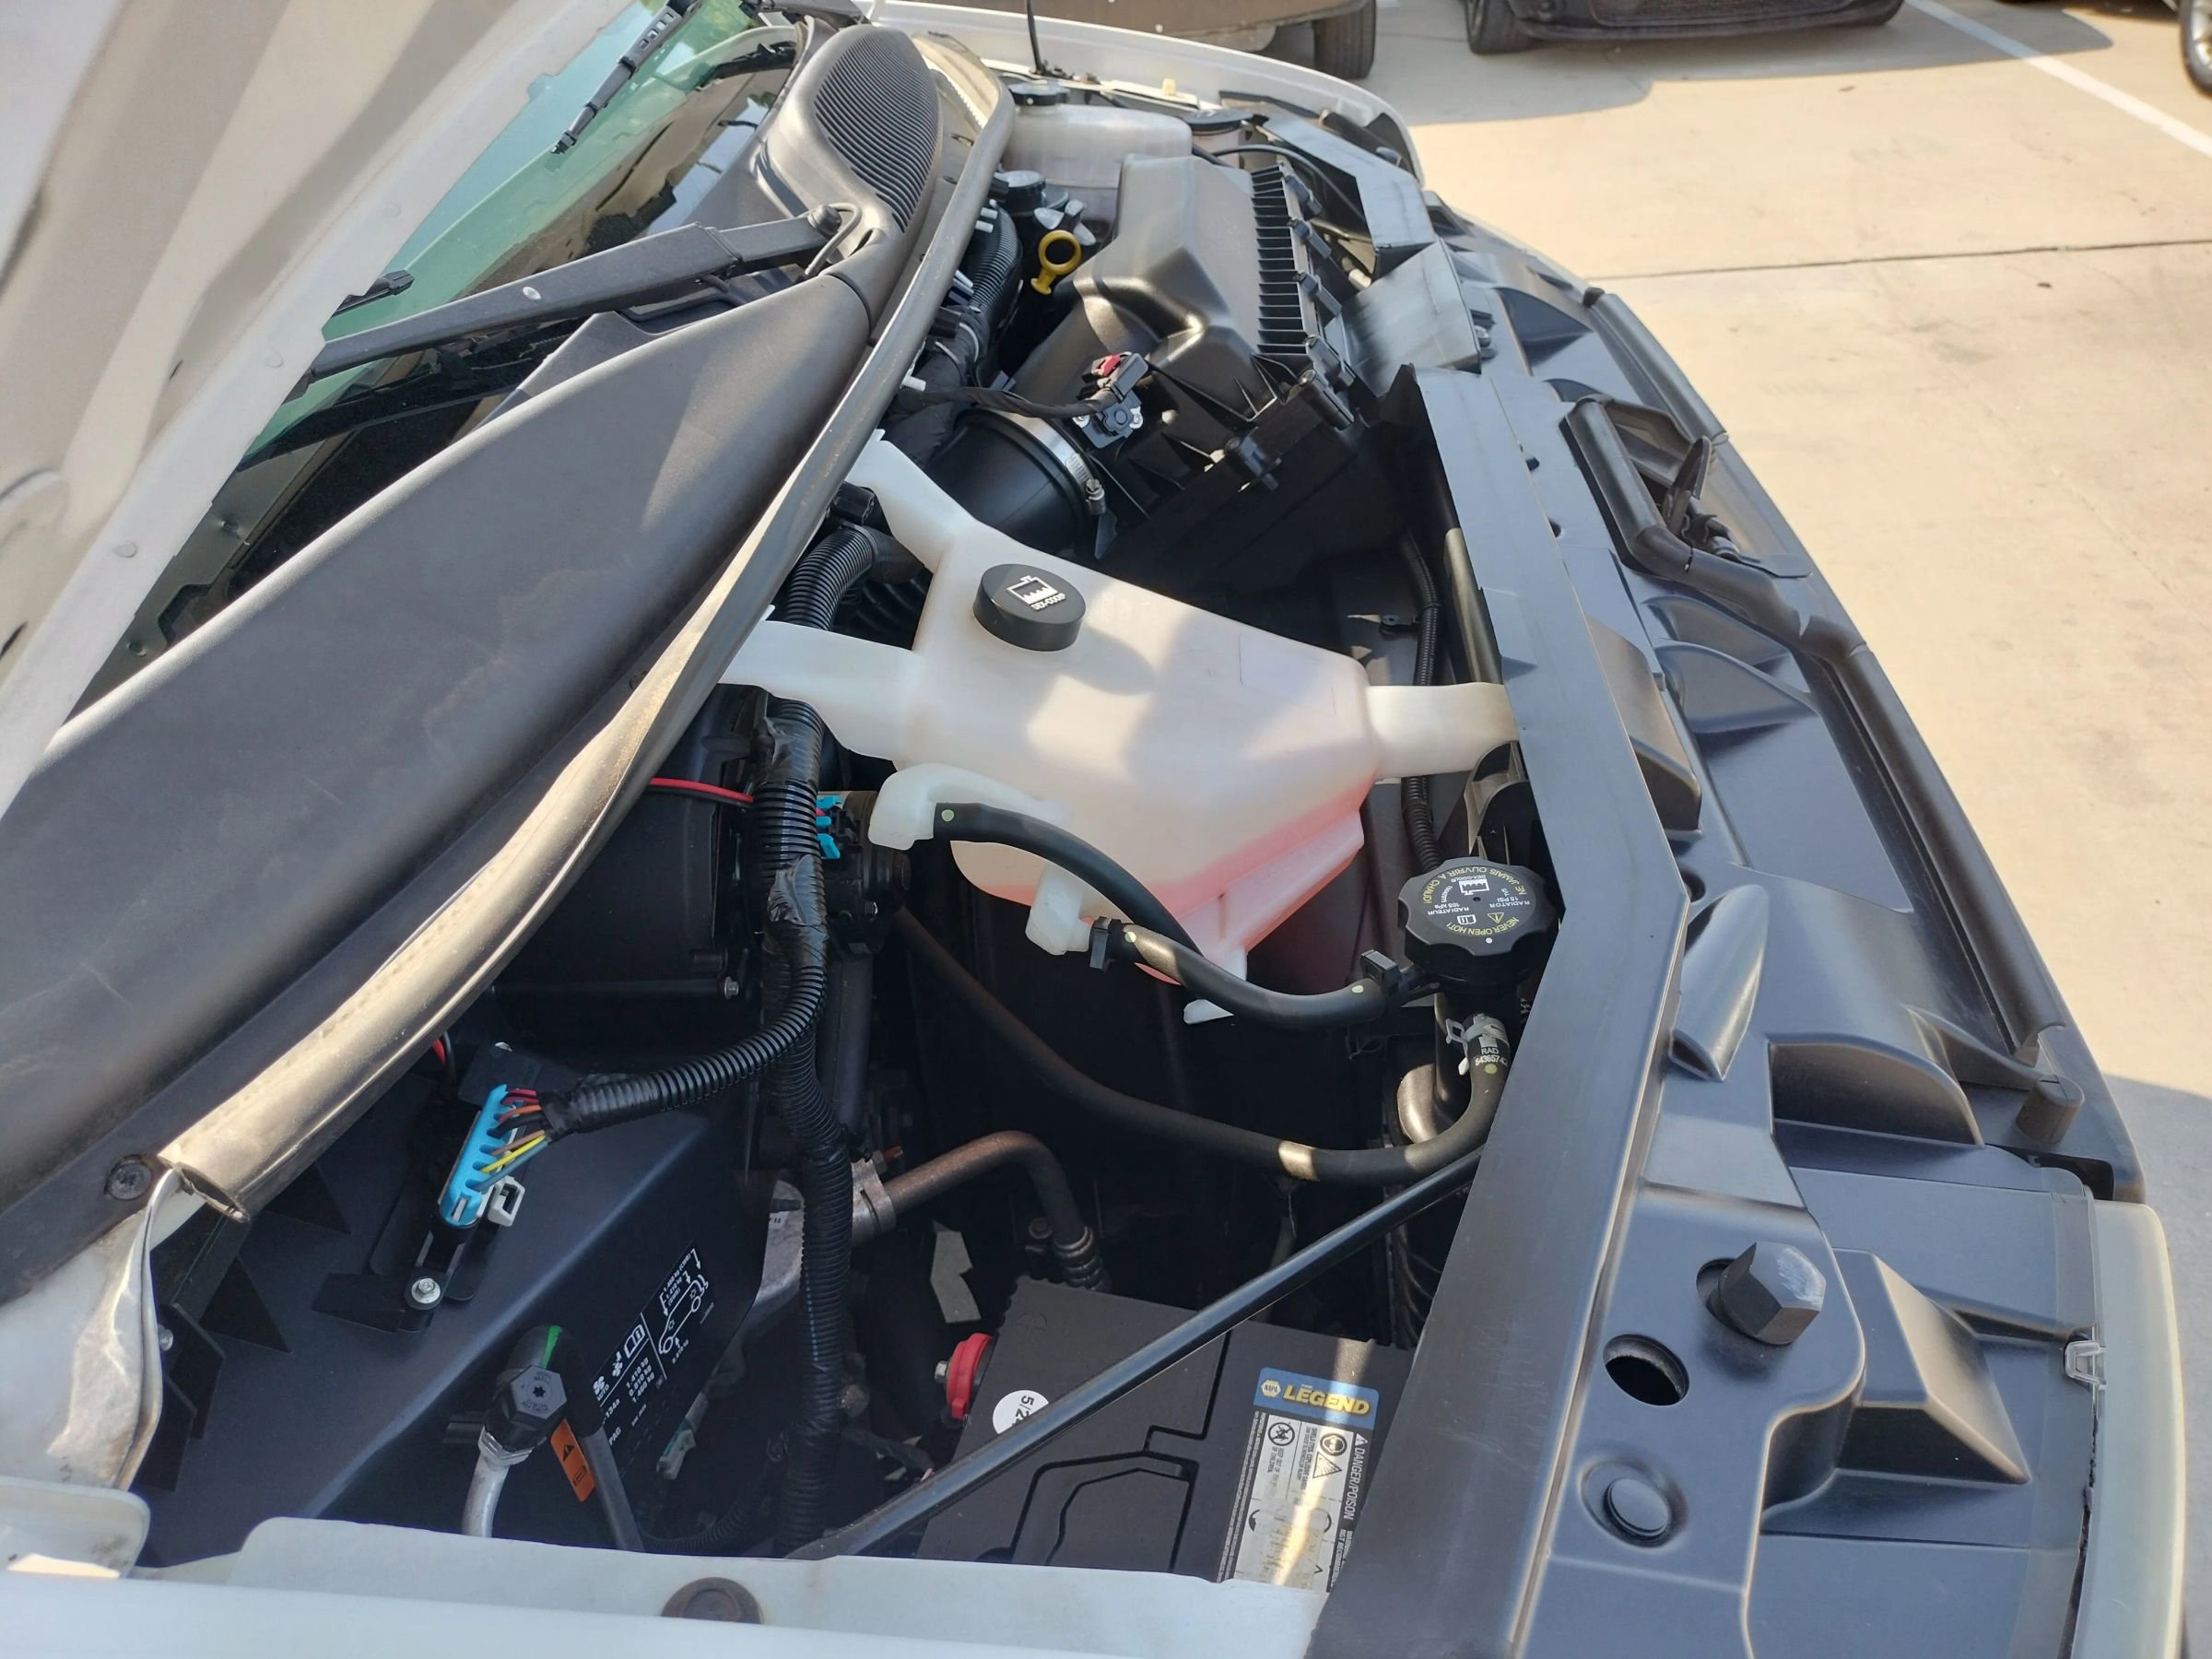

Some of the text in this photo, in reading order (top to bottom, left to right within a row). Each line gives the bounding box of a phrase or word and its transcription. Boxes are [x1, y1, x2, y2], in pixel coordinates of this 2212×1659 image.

[1447, 866, 1488, 877] OUVRIR
[1488, 868, 1520, 885] JAMAIS
[1514, 885, 1527, 895] NE
[1488, 900, 1531, 908] RADIATOR
[1427, 906, 1470, 915] RADIATEUR
[1492, 916, 1520, 934] NEVER
[1467, 927, 1493, 935] OPEN
[1481, 1047, 1500, 1055] RAD
[1264, 1383, 1279, 1394] NAPA
[1282, 1384, 1371, 1416] LEGEND
[1011, 1394, 1035, 1426] 5/2
[608, 1426, 622, 1446] PAG
[1343, 1447, 1366, 1521] DANGER/POISON
